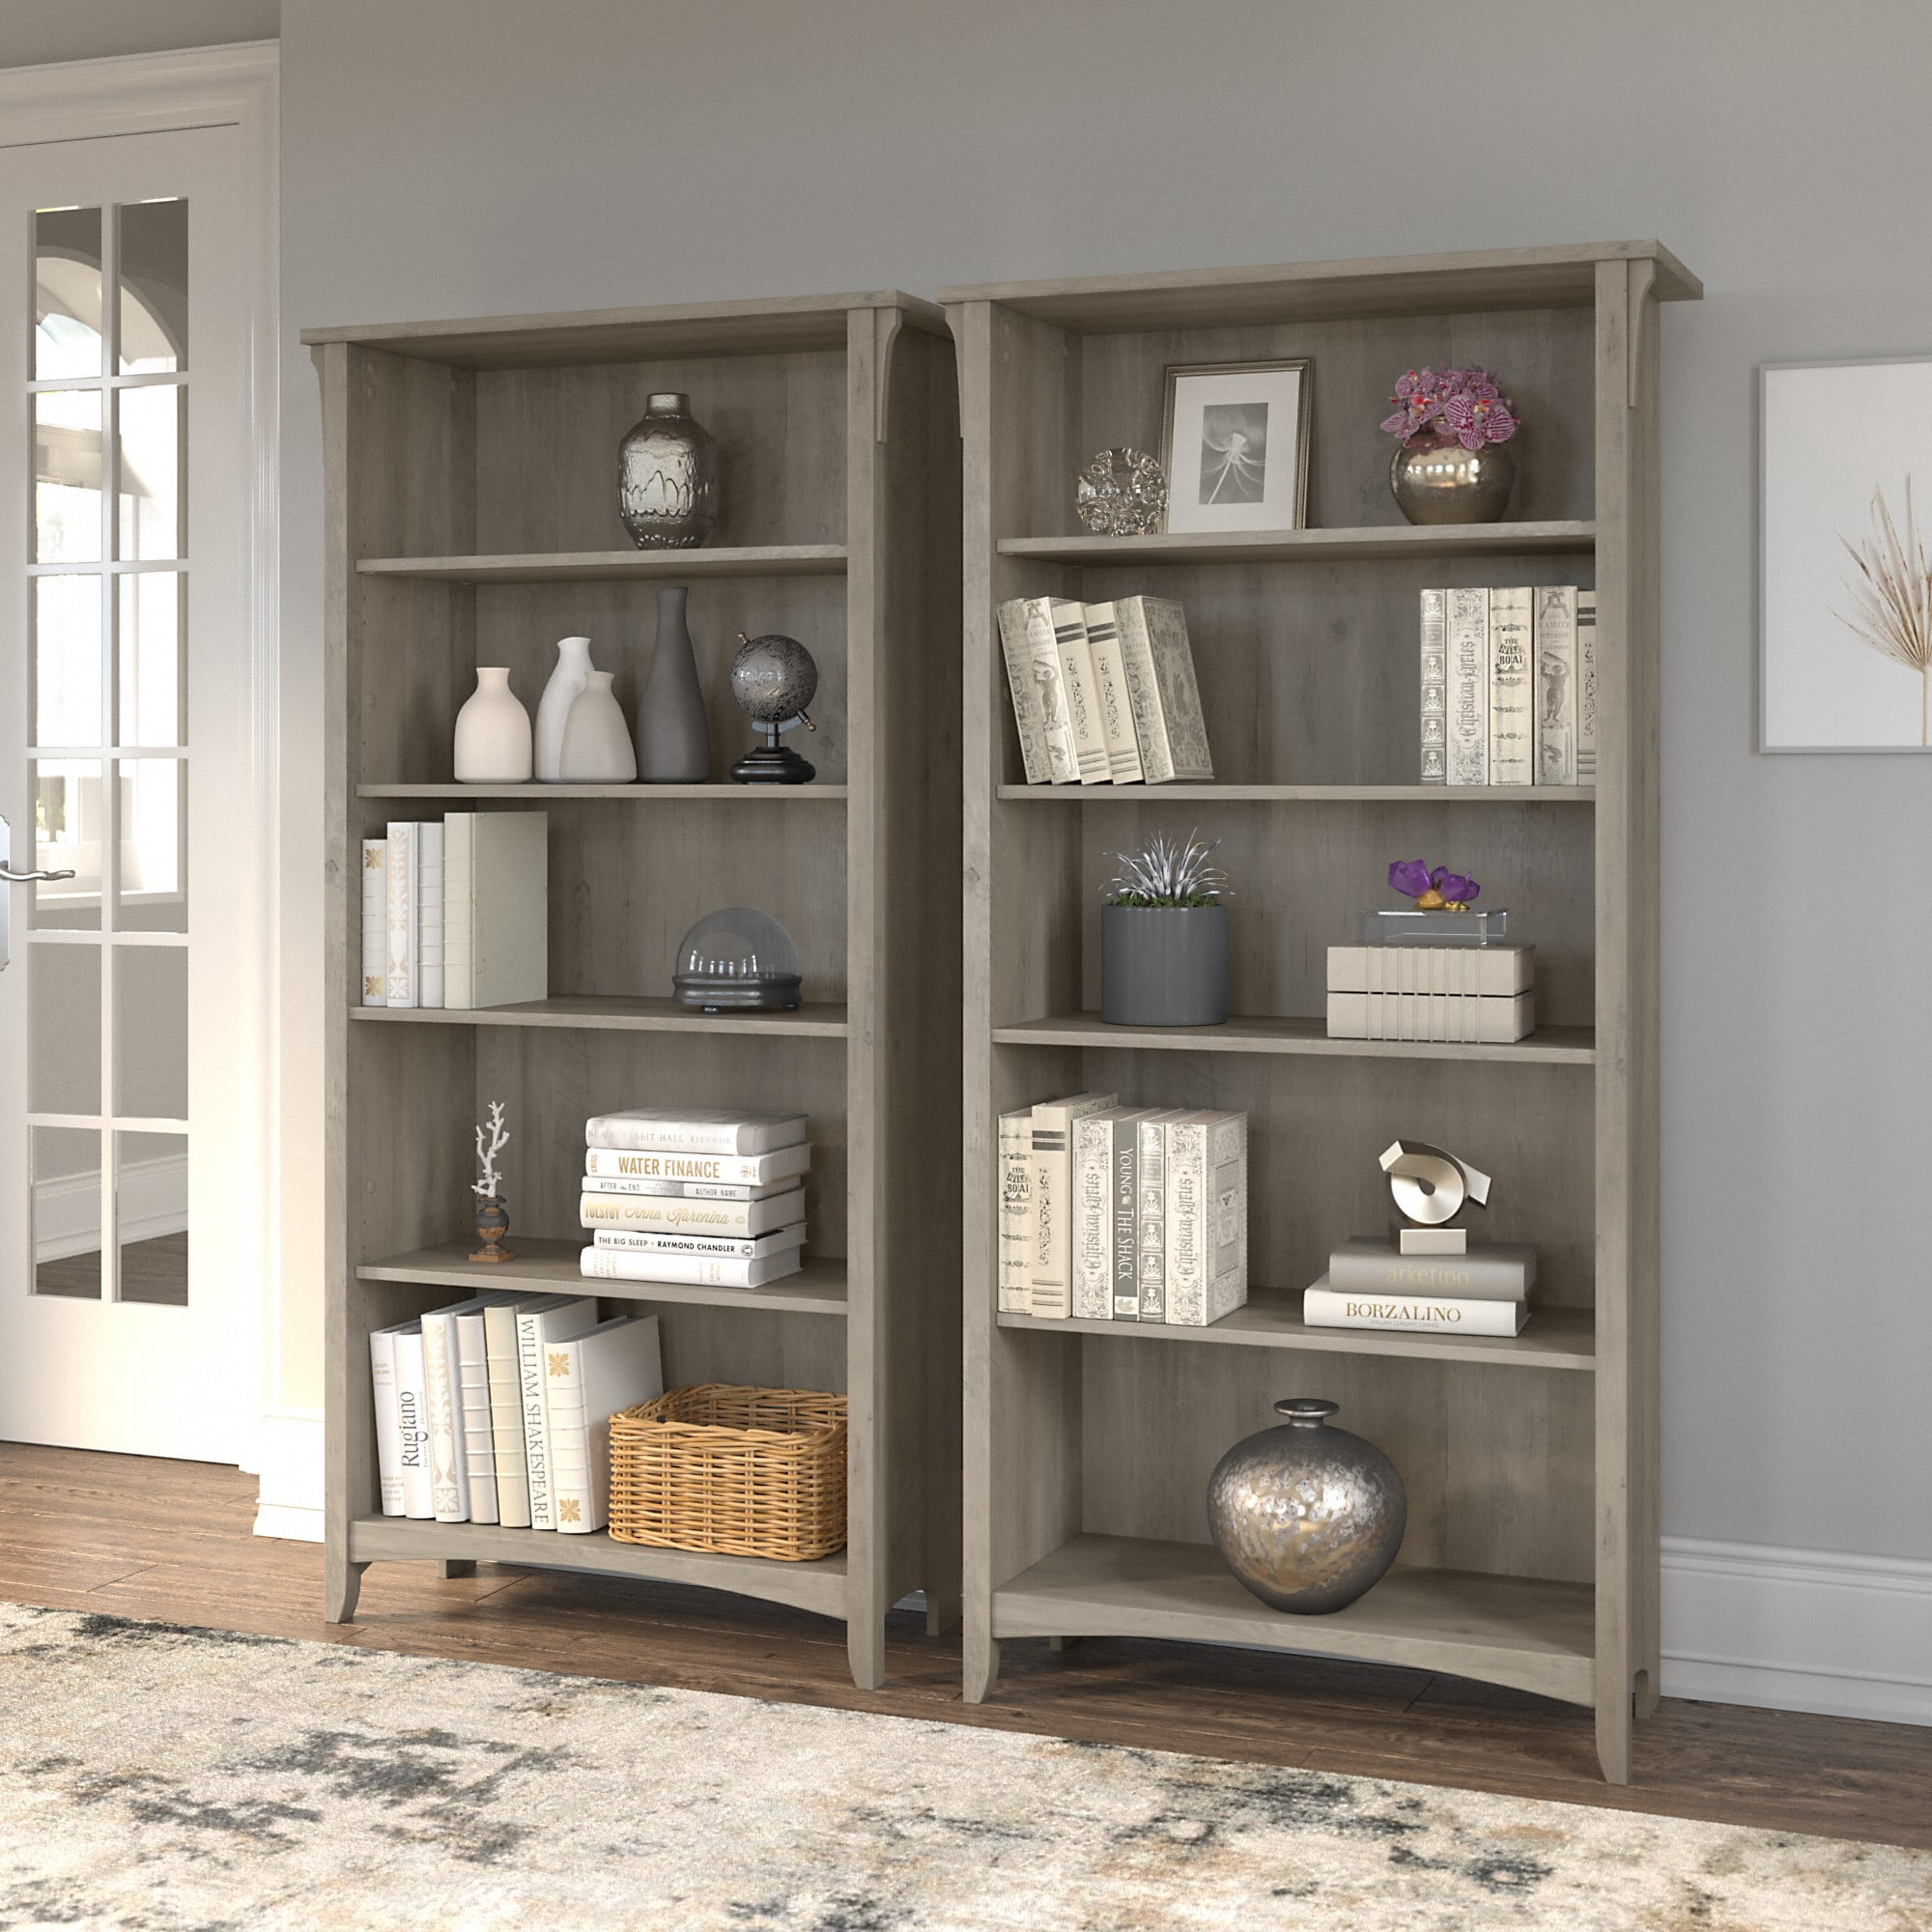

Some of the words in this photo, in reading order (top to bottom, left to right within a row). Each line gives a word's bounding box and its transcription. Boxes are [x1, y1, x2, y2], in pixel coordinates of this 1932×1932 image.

[618, 1156, 660, 1176] WATER
[665, 1159, 720, 1179] FINANCE
[1119, 1148, 1134, 1194] YOUNG
[696, 1187, 718, 1197] AUTHOR
[721, 1188, 737, 1198] NAME
[585, 1204, 619, 1220] TOLSTOY
[625, 1207, 663, 1221] Anna
[667, 1208, 730, 1227] Karenina
[1118, 1208, 1134, 1234] THE
[628, 1238, 648, 1247] SLEEP
[657, 1240, 695, 1251] RAYMOND
[696, 1242, 735, 1253] CHANDLER
[1118, 1236, 1134, 1280] SHACK
[1346, 1302, 1462, 1323] BORZALINO
[520, 1319, 540, 1398] WILLIAM
[399, 1391, 429, 1468] Rugiano
[526, 1402, 550, 1524] SHAKESPEARE
